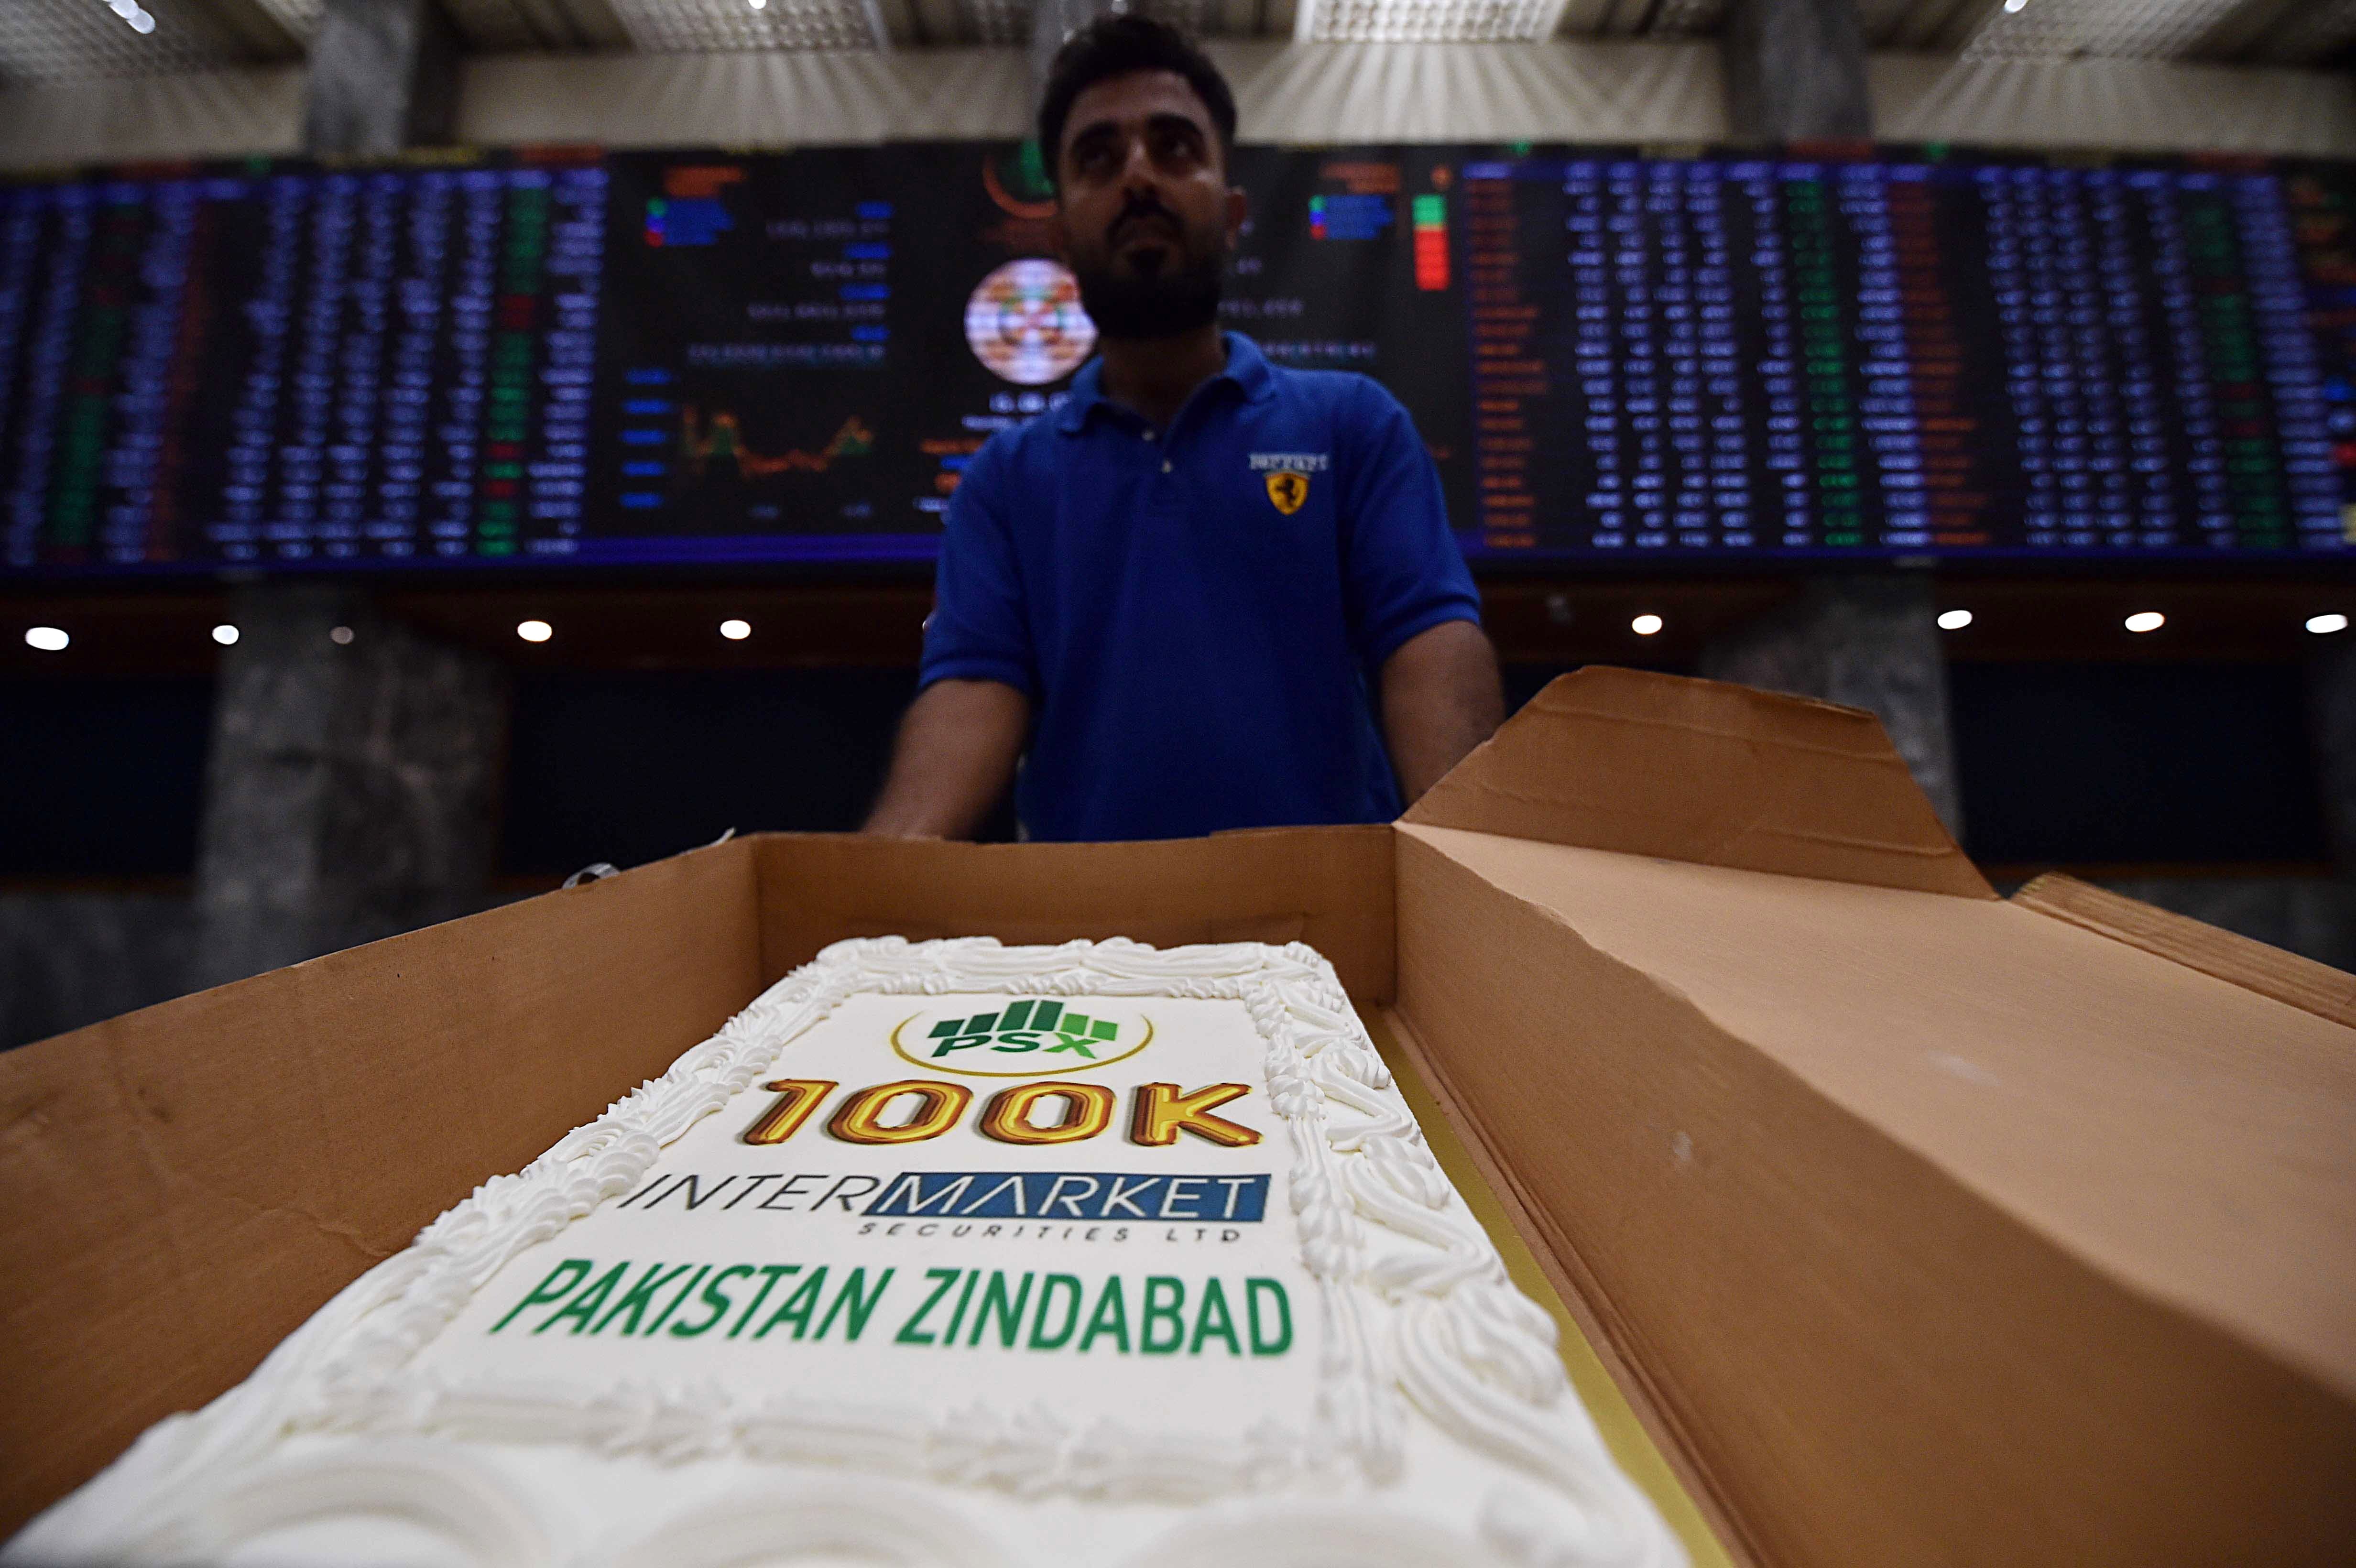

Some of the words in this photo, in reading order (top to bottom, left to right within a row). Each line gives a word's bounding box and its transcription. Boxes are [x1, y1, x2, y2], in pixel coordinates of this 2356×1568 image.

[932, 1033, 1099, 1059] PSX
[742, 1078, 1263, 1148] 100K
[858, 1221, 1129, 1242] SECURITIES
[1166, 1229, 1241, 1243] LTD
[490, 1259, 895, 1341] PAKISTAN
[896, 1269, 1293, 1356] ZINDABAD
